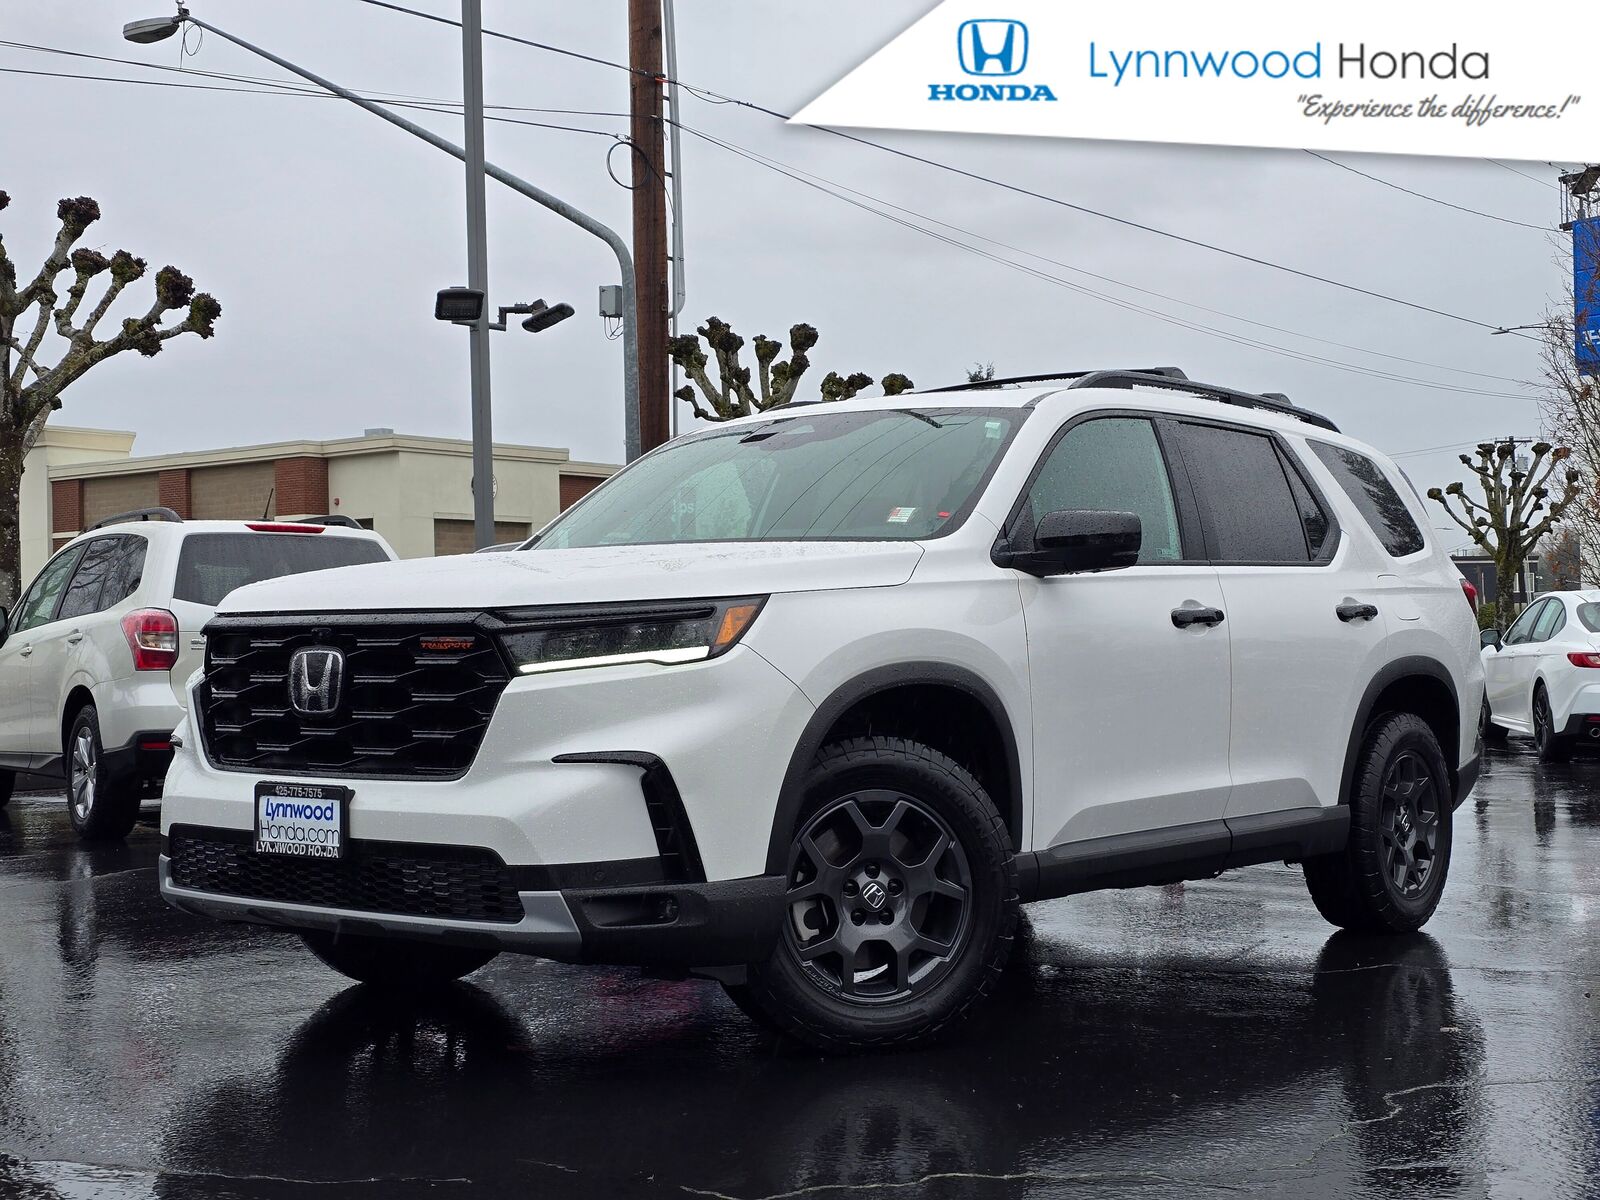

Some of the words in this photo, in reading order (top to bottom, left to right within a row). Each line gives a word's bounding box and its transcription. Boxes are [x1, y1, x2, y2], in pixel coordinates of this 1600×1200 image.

[275, 785, 323, 798] 425-775-7575
[265, 797, 334, 821] Lynnwood
[260, 819, 340, 845] Honda.com
[255, 840, 306, 855] LYNNWOOD
